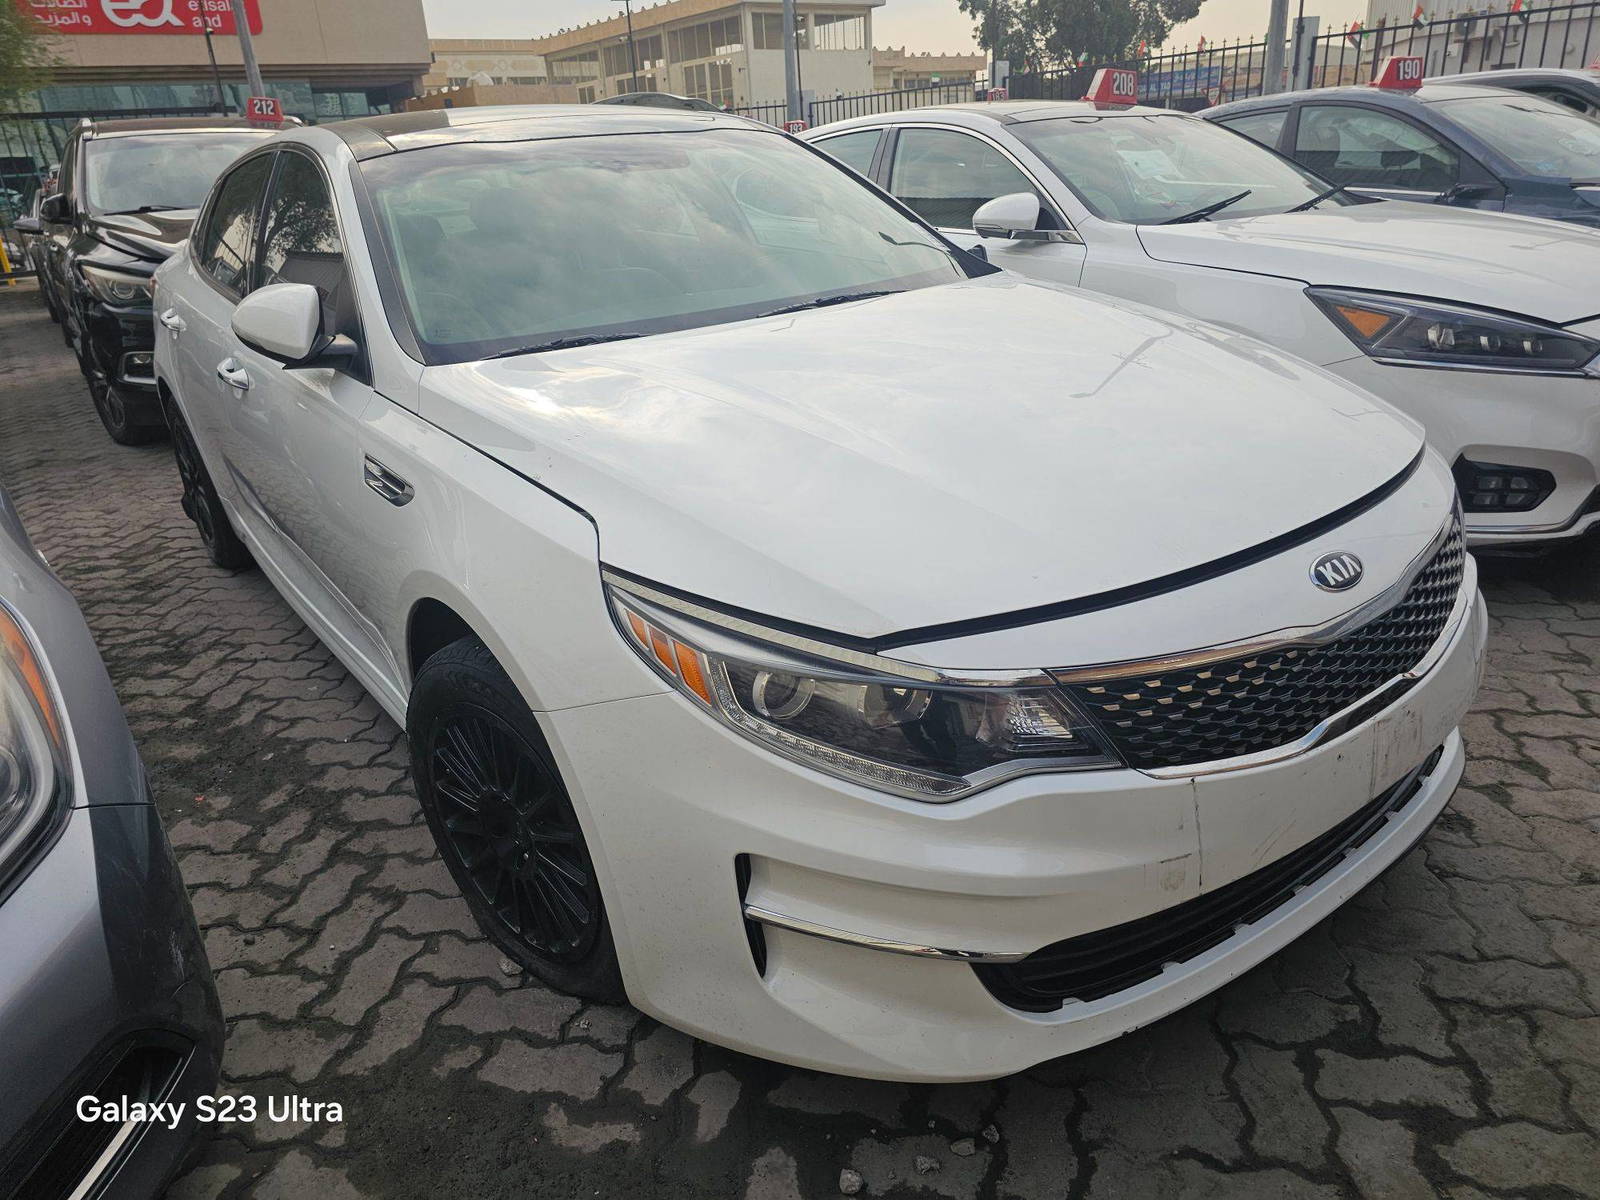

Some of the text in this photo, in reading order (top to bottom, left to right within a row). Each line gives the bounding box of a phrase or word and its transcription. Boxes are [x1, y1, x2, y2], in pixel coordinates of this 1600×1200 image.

[1398, 59, 1420, 80] 190
[1113, 72, 1134, 96] 208
[253, 99, 275, 116] 212
[1316, 555, 1361, 586] KIA
